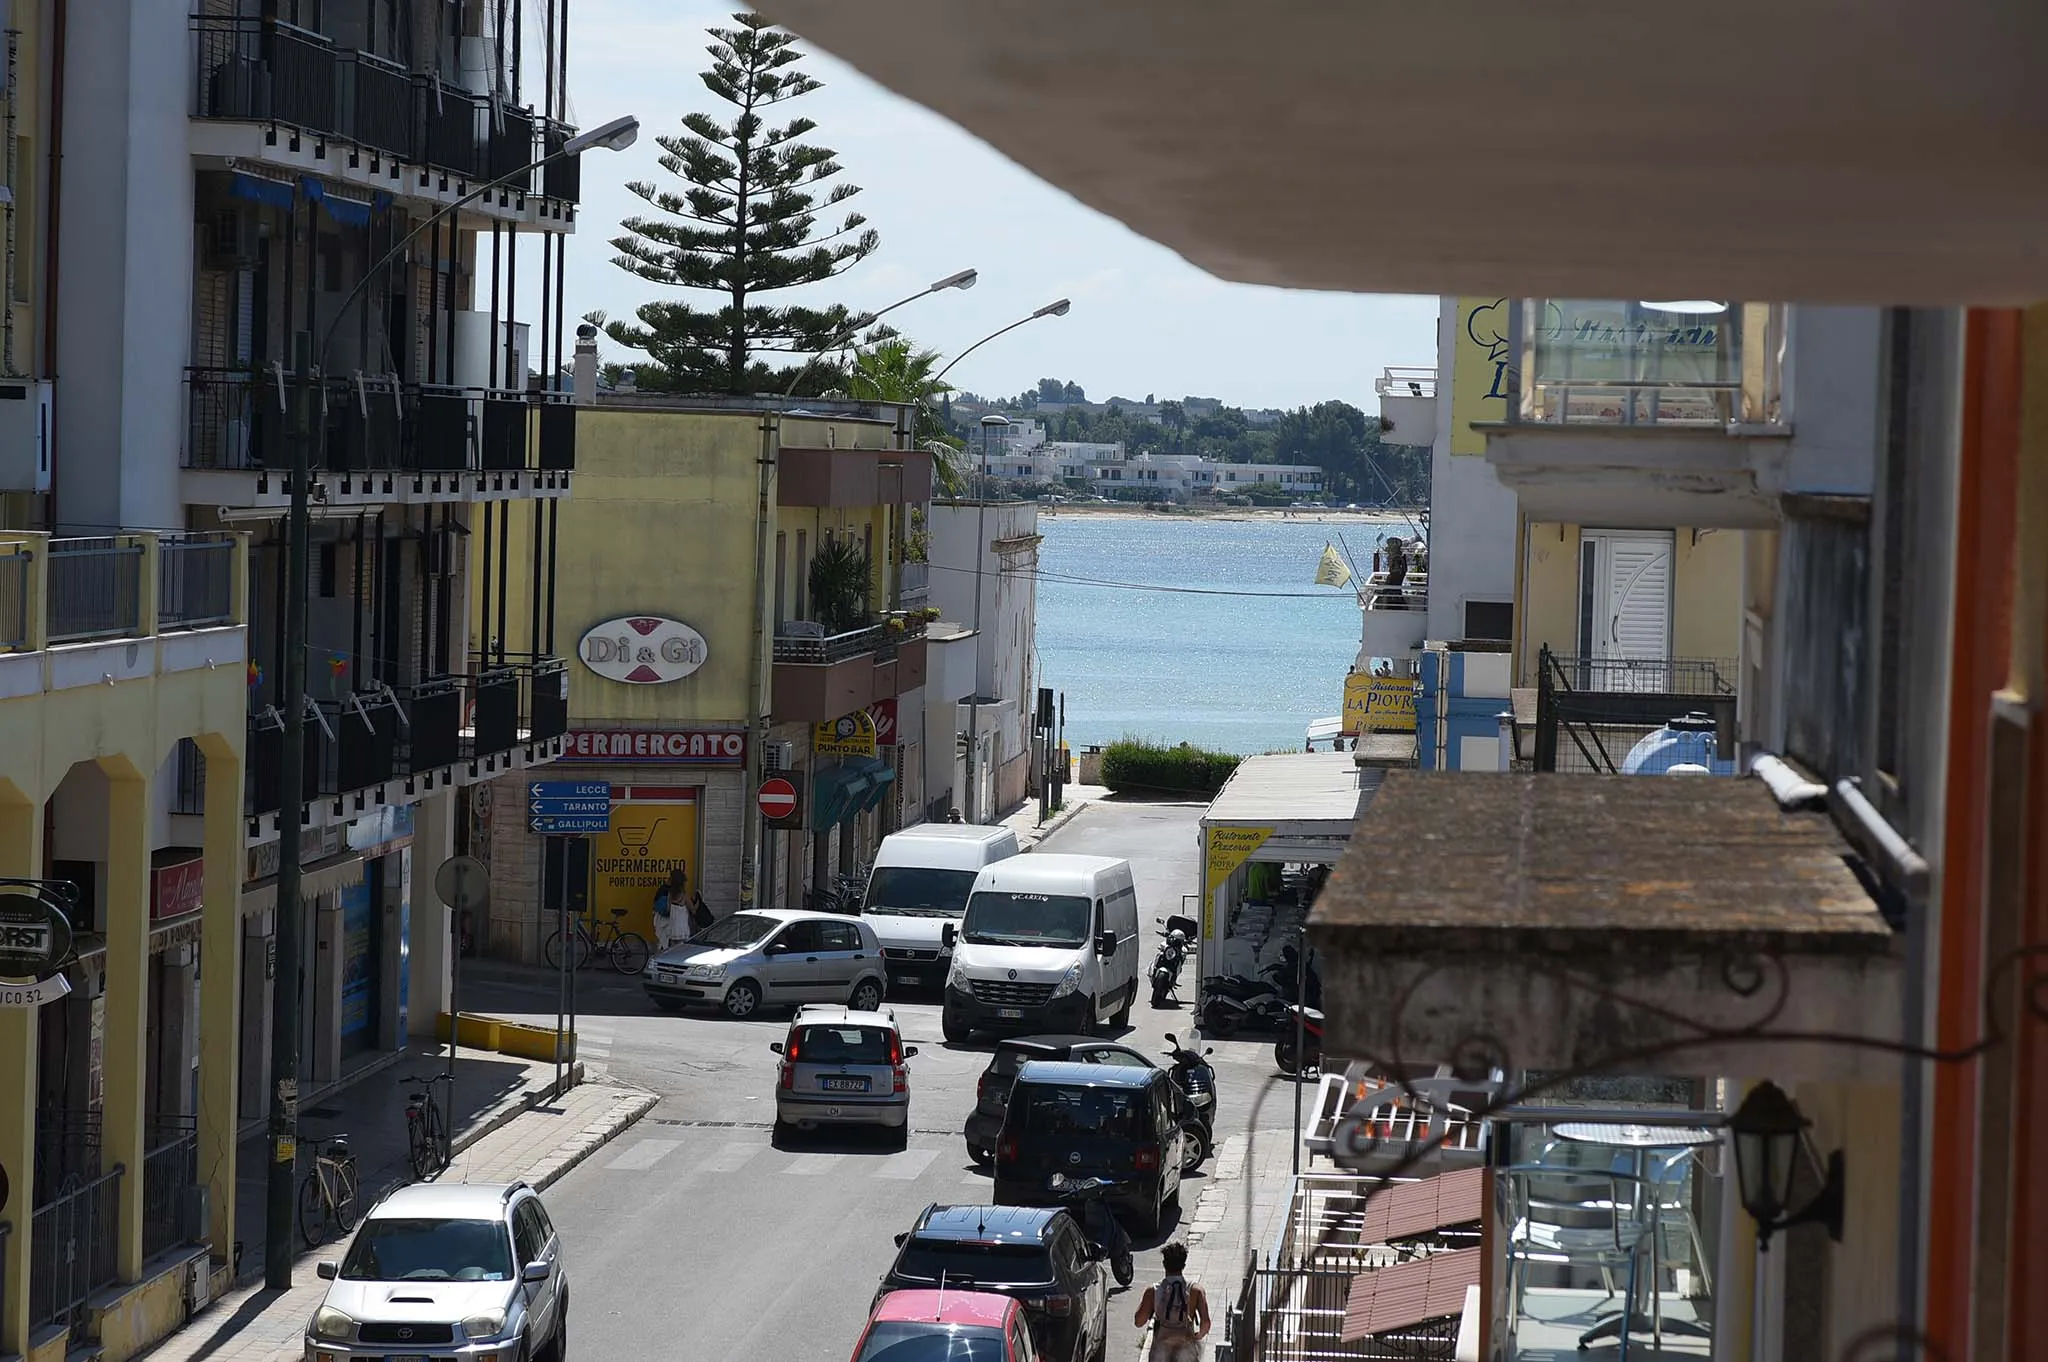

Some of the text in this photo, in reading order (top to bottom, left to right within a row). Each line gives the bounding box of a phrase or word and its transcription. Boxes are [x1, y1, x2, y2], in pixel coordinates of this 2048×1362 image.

[587, 636, 702, 664] Di & Gi
[1347, 692, 1414, 713] LA PIOVR
[818, 743, 871, 755] PUNTO BAR
[576, 785, 607, 794] LECCE
[563, 803, 607, 811] TARANTO
[558, 820, 607, 829] GALLIPOLI
[1212, 830, 1260, 841] Ristorante
[1210, 840, 1251, 851] Pizzeria
[596, 859, 686, 873] SUPERMERCATO
[609, 877, 635, 888] PORTO
[26, 989, 43, 1003] 32
